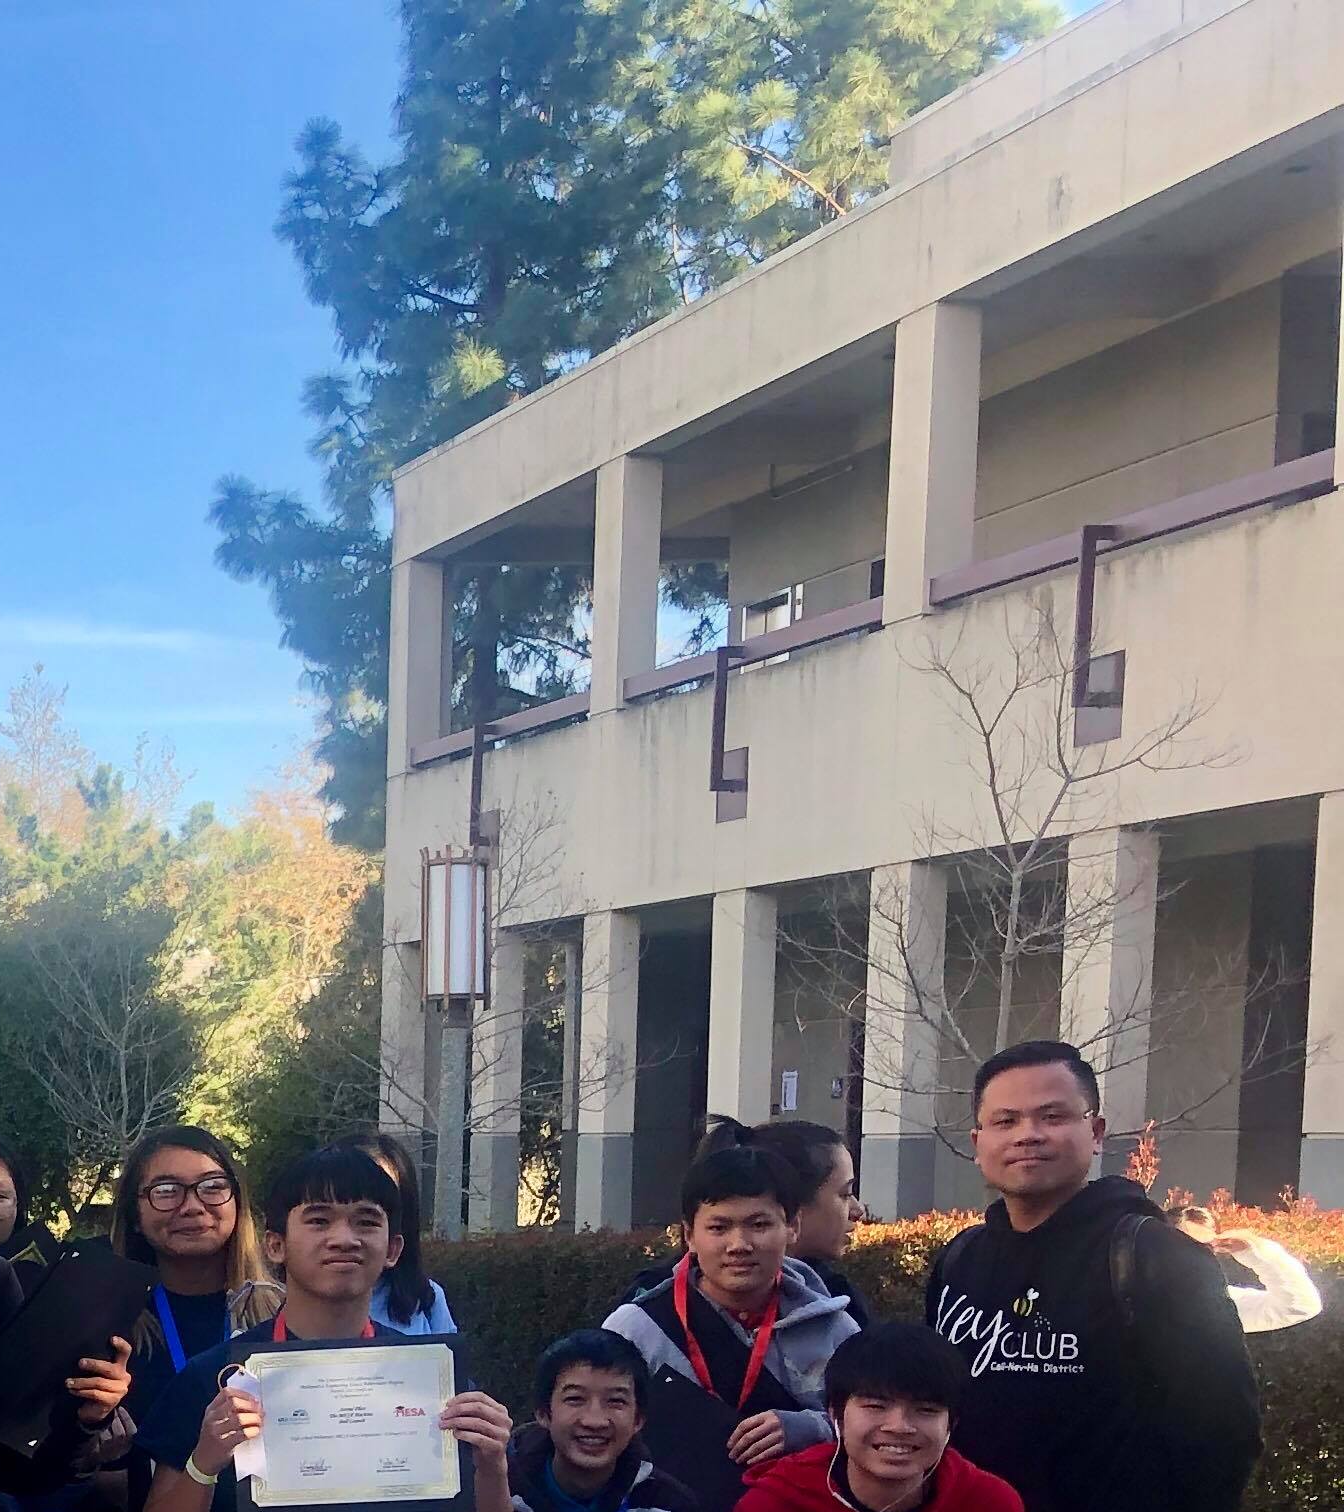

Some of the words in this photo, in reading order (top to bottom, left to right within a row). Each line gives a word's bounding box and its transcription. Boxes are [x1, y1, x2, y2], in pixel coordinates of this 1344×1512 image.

[1001, 1332, 1079, 1360] CLUB
[1044, 1362, 1085, 1374] District
[395, 1407, 426, 1417] MESA
